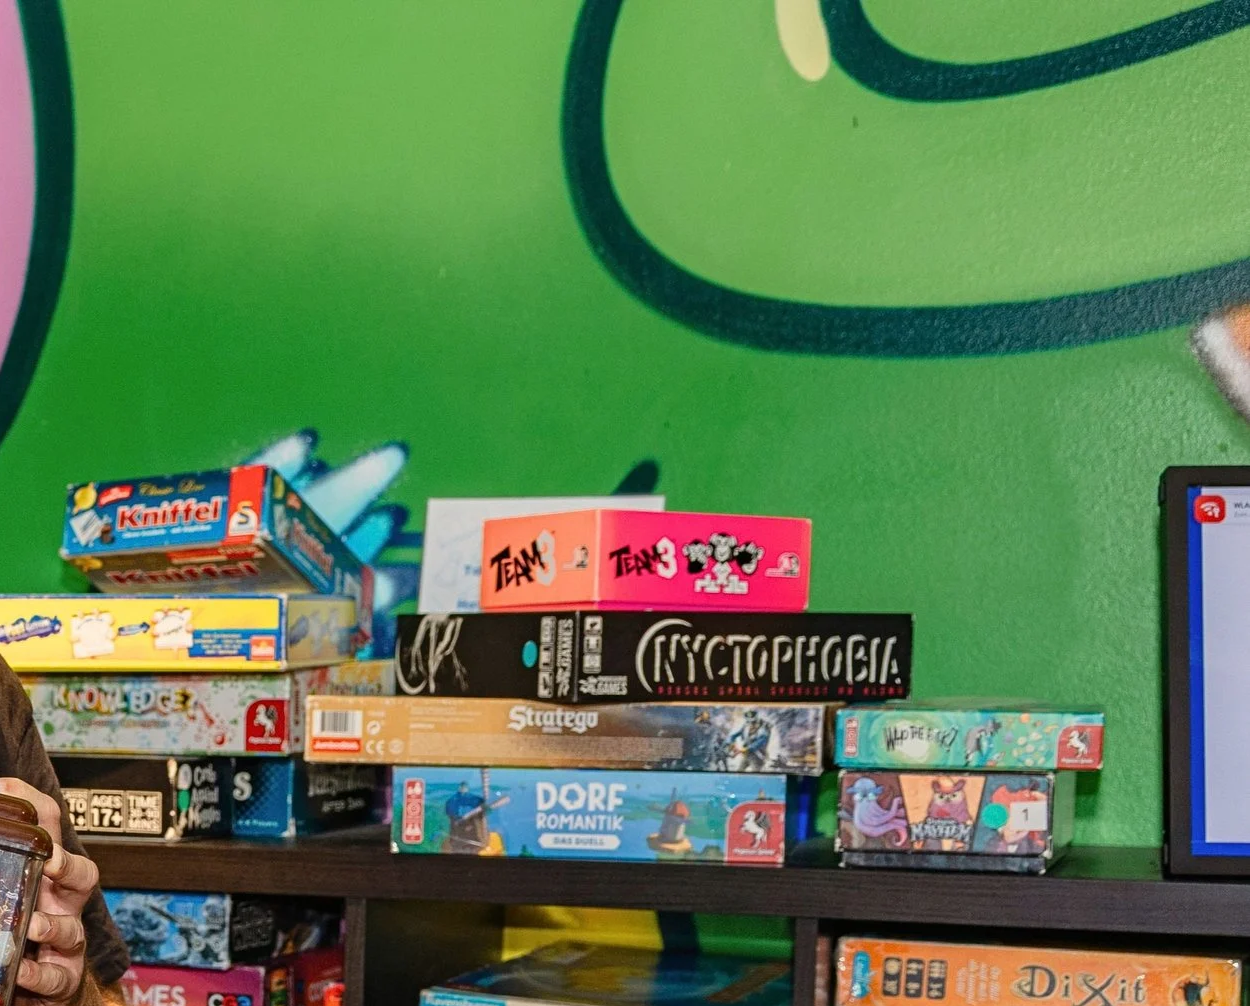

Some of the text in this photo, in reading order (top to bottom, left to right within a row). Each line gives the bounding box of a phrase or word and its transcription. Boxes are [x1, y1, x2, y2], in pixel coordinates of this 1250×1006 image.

[116, 496, 224, 531] Kniffel
[507, 705, 599, 733] Stratego
[91, 795, 122, 808] AGES
[536, 782, 627, 812] DORF
[92, 807, 124, 828] 17+
[536, 814, 622, 832] ROMANTIK
[910, 823, 971, 842] MAYHEM
